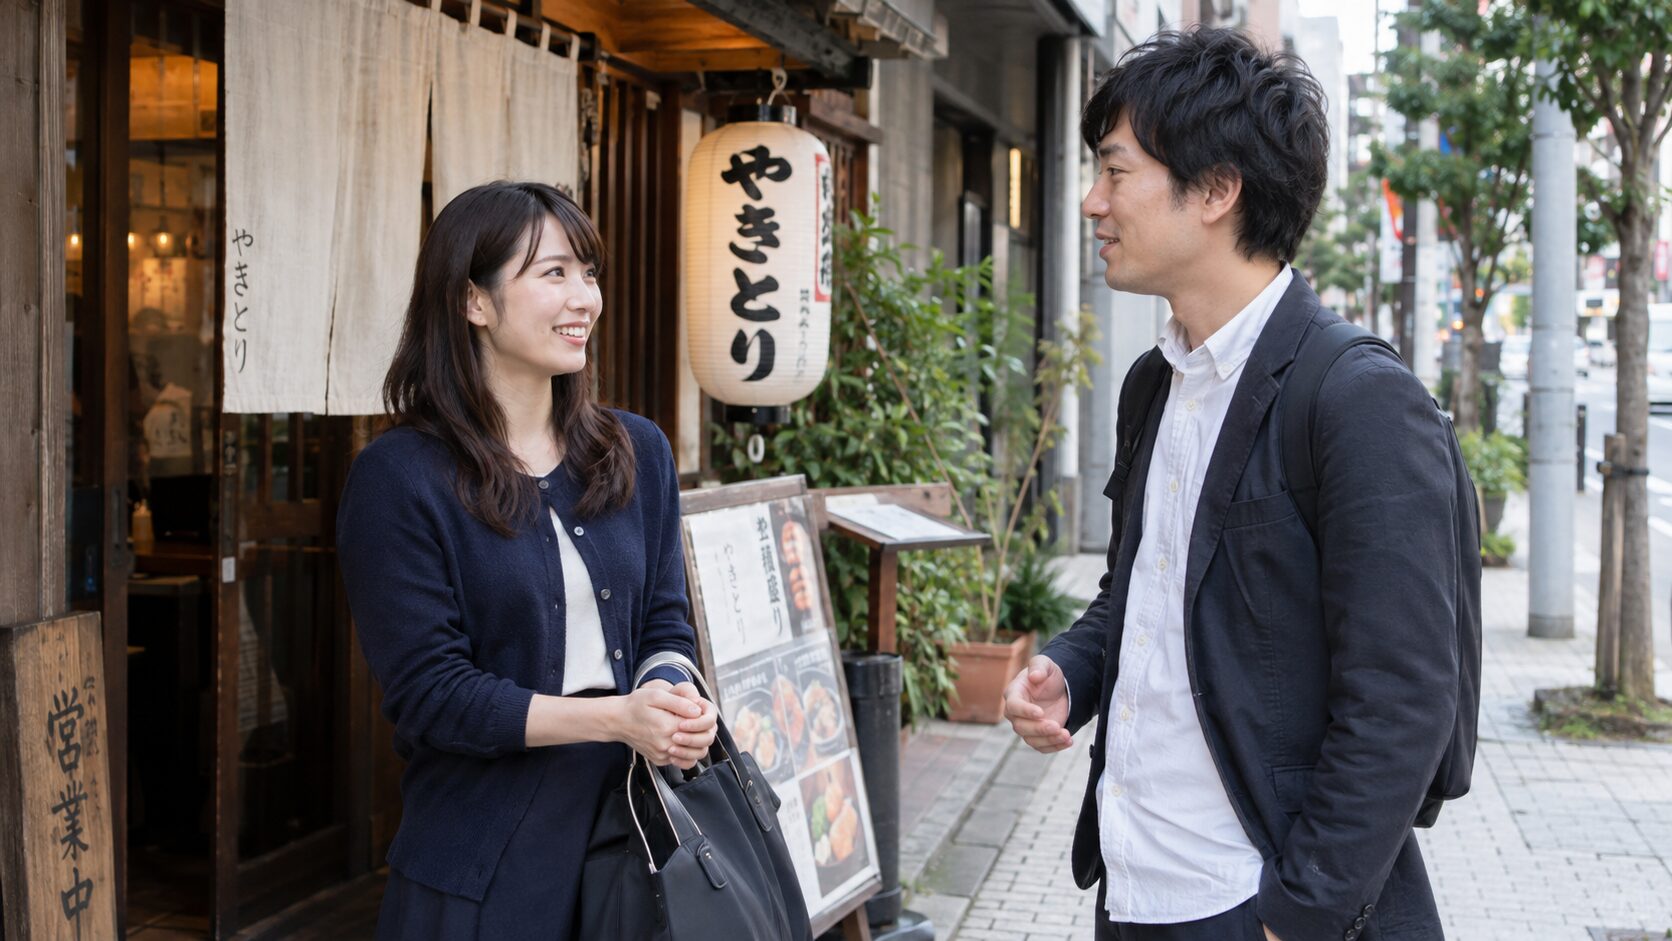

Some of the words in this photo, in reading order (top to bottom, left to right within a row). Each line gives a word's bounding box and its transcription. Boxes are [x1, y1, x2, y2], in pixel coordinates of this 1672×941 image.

[232, 228, 254, 374] やきとり
[721, 145, 793, 382] やきとり
[48, 686, 94, 941] 営業中
